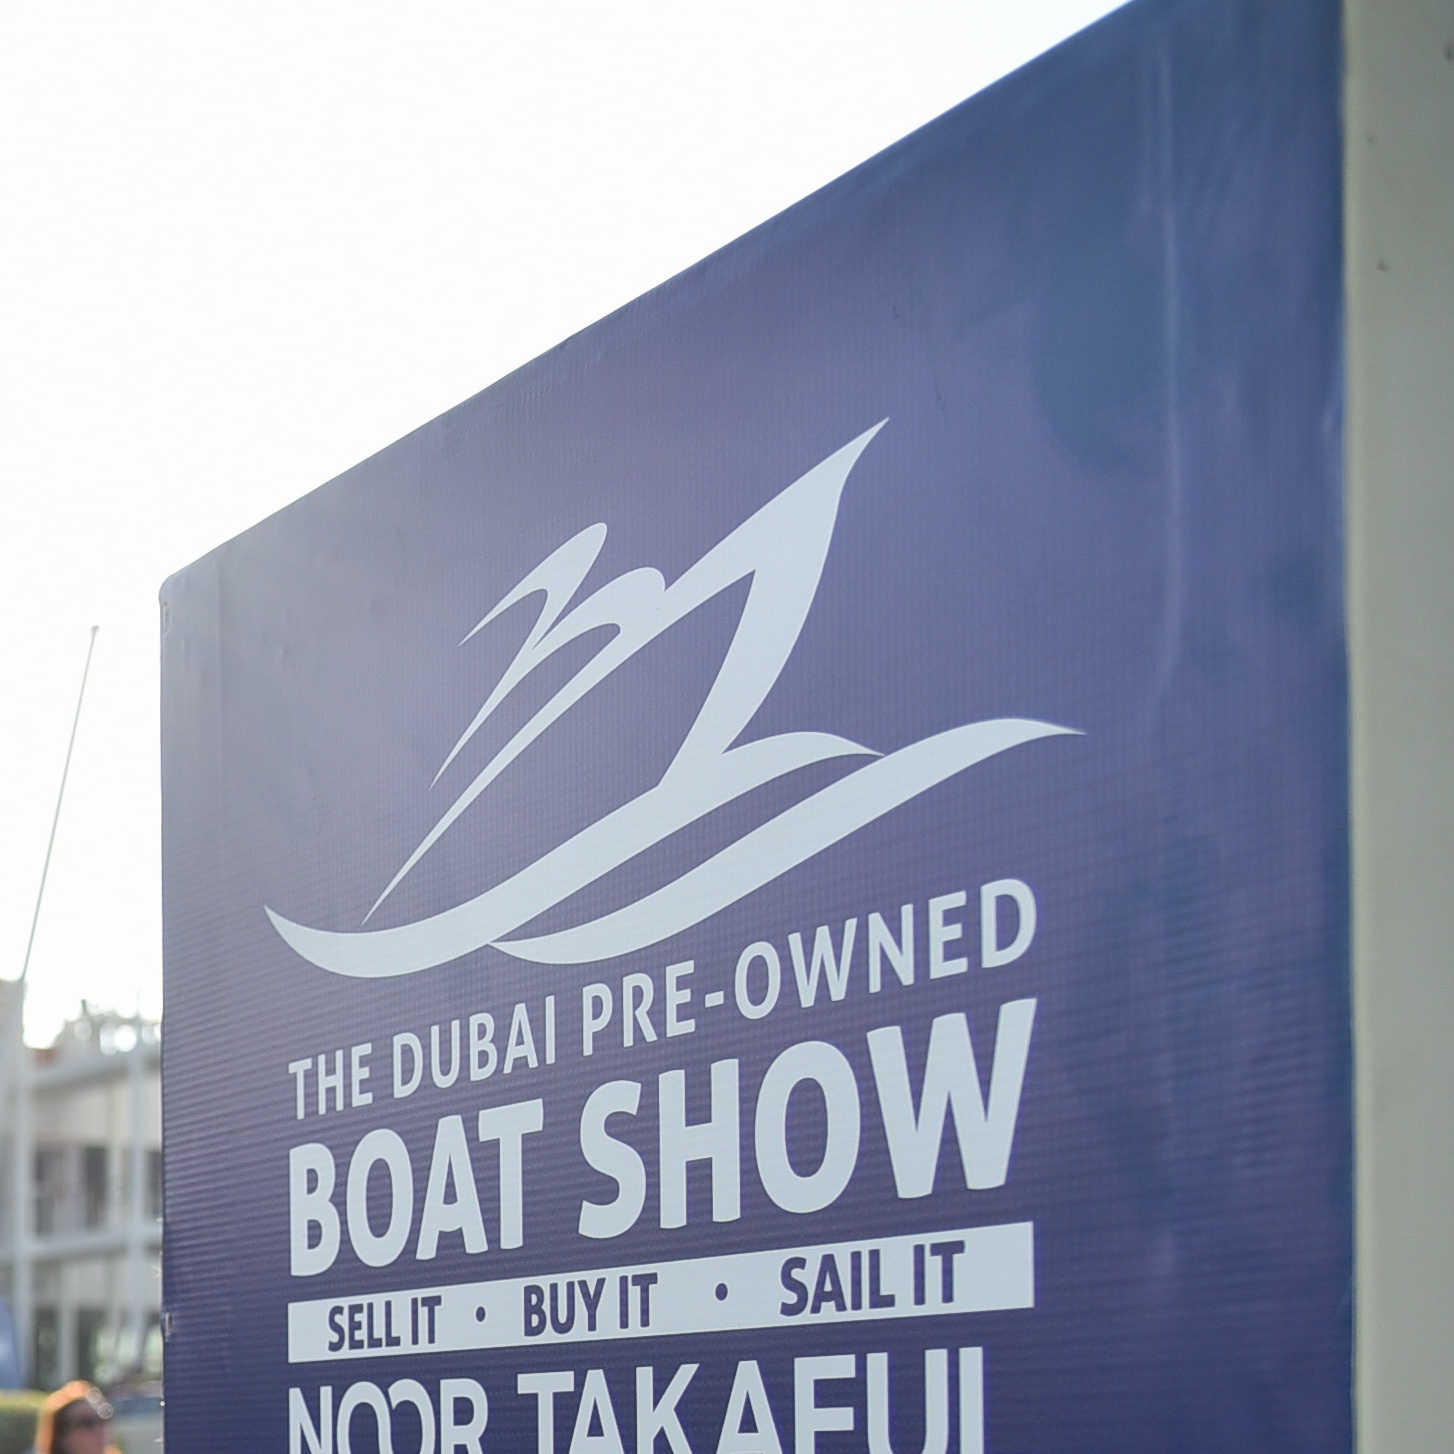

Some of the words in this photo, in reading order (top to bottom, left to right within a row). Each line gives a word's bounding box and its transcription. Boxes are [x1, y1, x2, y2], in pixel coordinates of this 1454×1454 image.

[289, 1042, 374, 1120] THE
[393, 995, 556, 1099] DUBAI
[582, 878, 1037, 1057] PRE-OWNED
[289, 1098, 544, 1277] BOAT
[578, 997, 1038, 1239] SHOW
[327, 1301, 401, 1353] SELL
[410, 1294, 442, 1346] IT
[523, 1277, 607, 1337] BUY
[619, 1272, 659, 1330] IT
[779, 1248, 896, 1317] SAIL
[913, 1239, 966, 1307] IT
